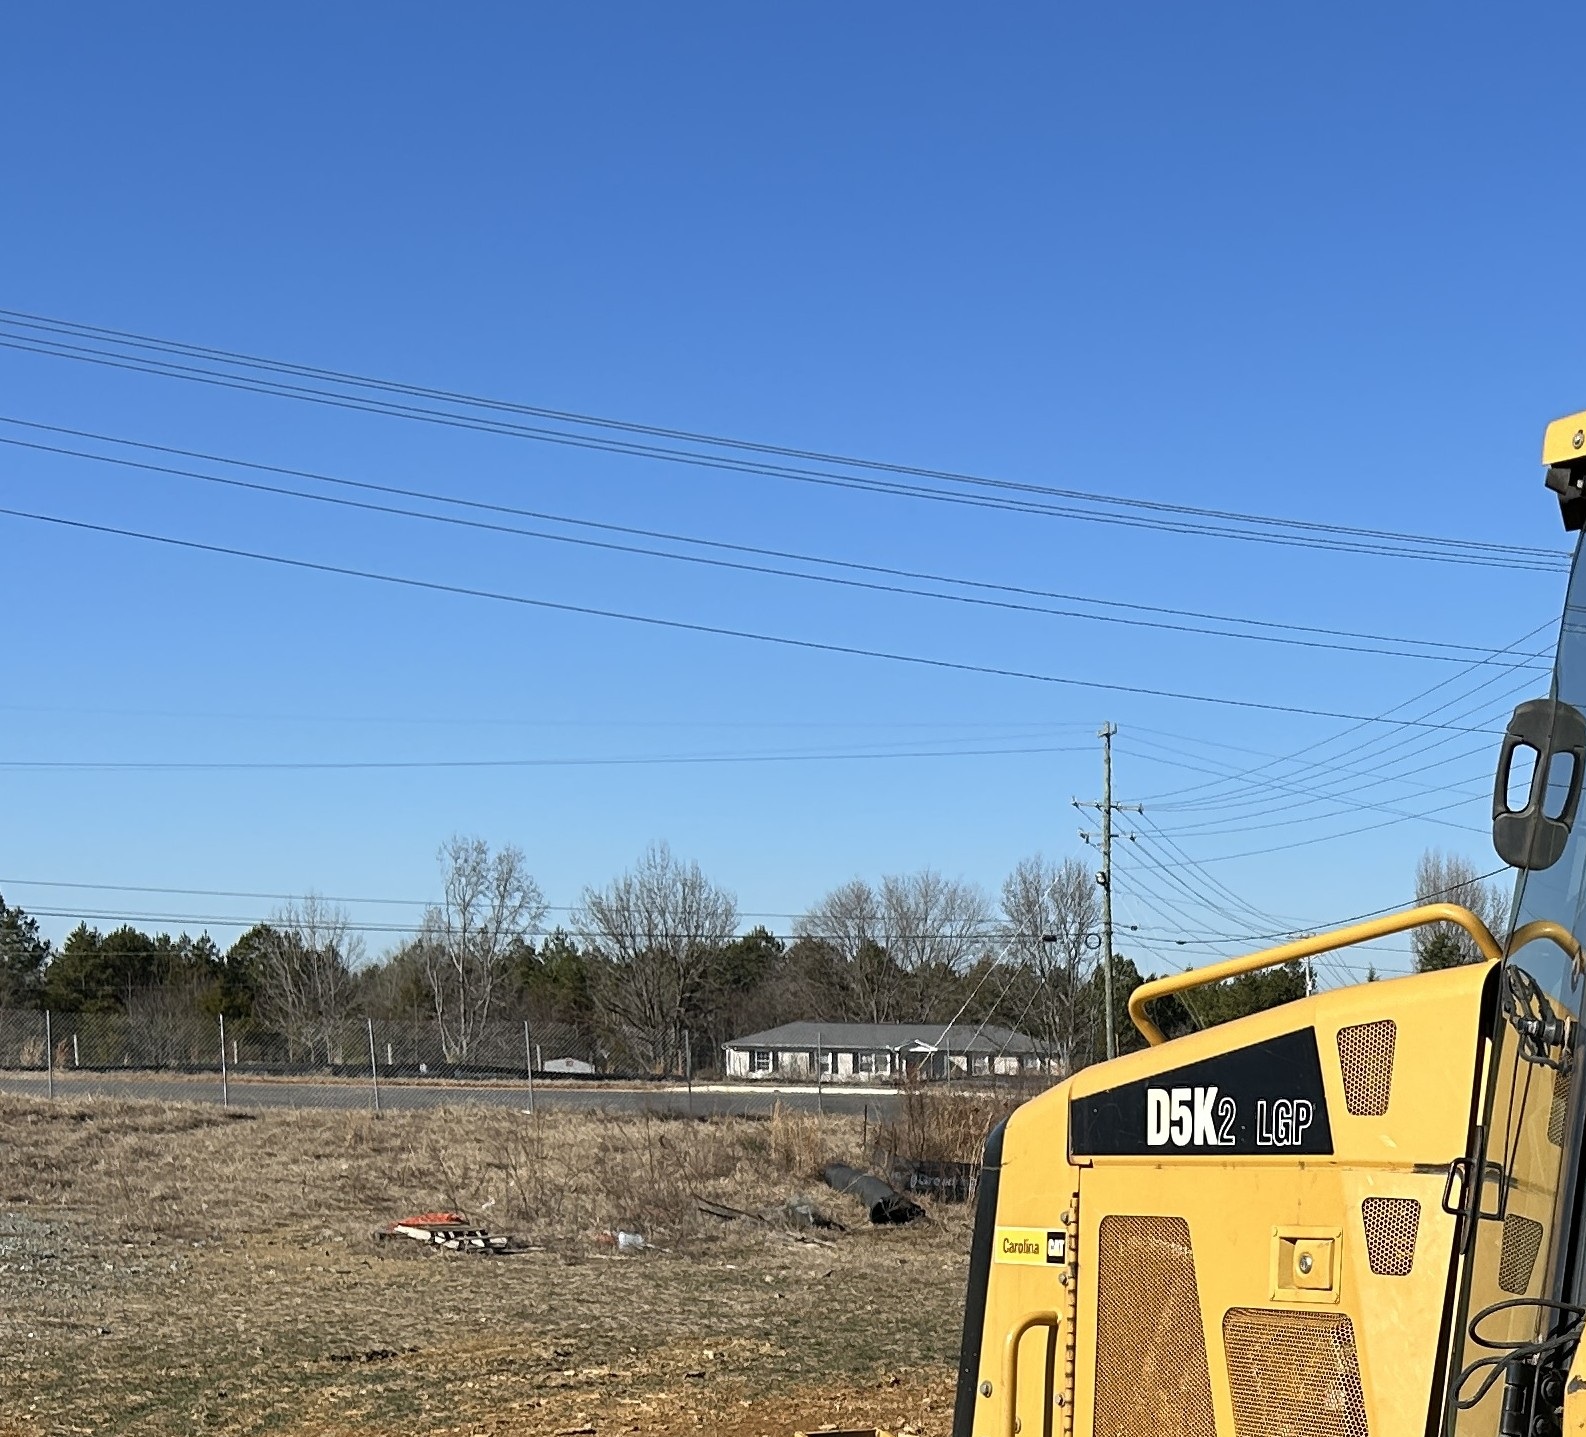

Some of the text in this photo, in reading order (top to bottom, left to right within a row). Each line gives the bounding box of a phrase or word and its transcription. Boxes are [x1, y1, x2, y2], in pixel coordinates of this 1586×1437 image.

[1147, 1086, 1314, 1147] D5K2 LGP
[1003, 1237, 1065, 1256] Carolina CAT
